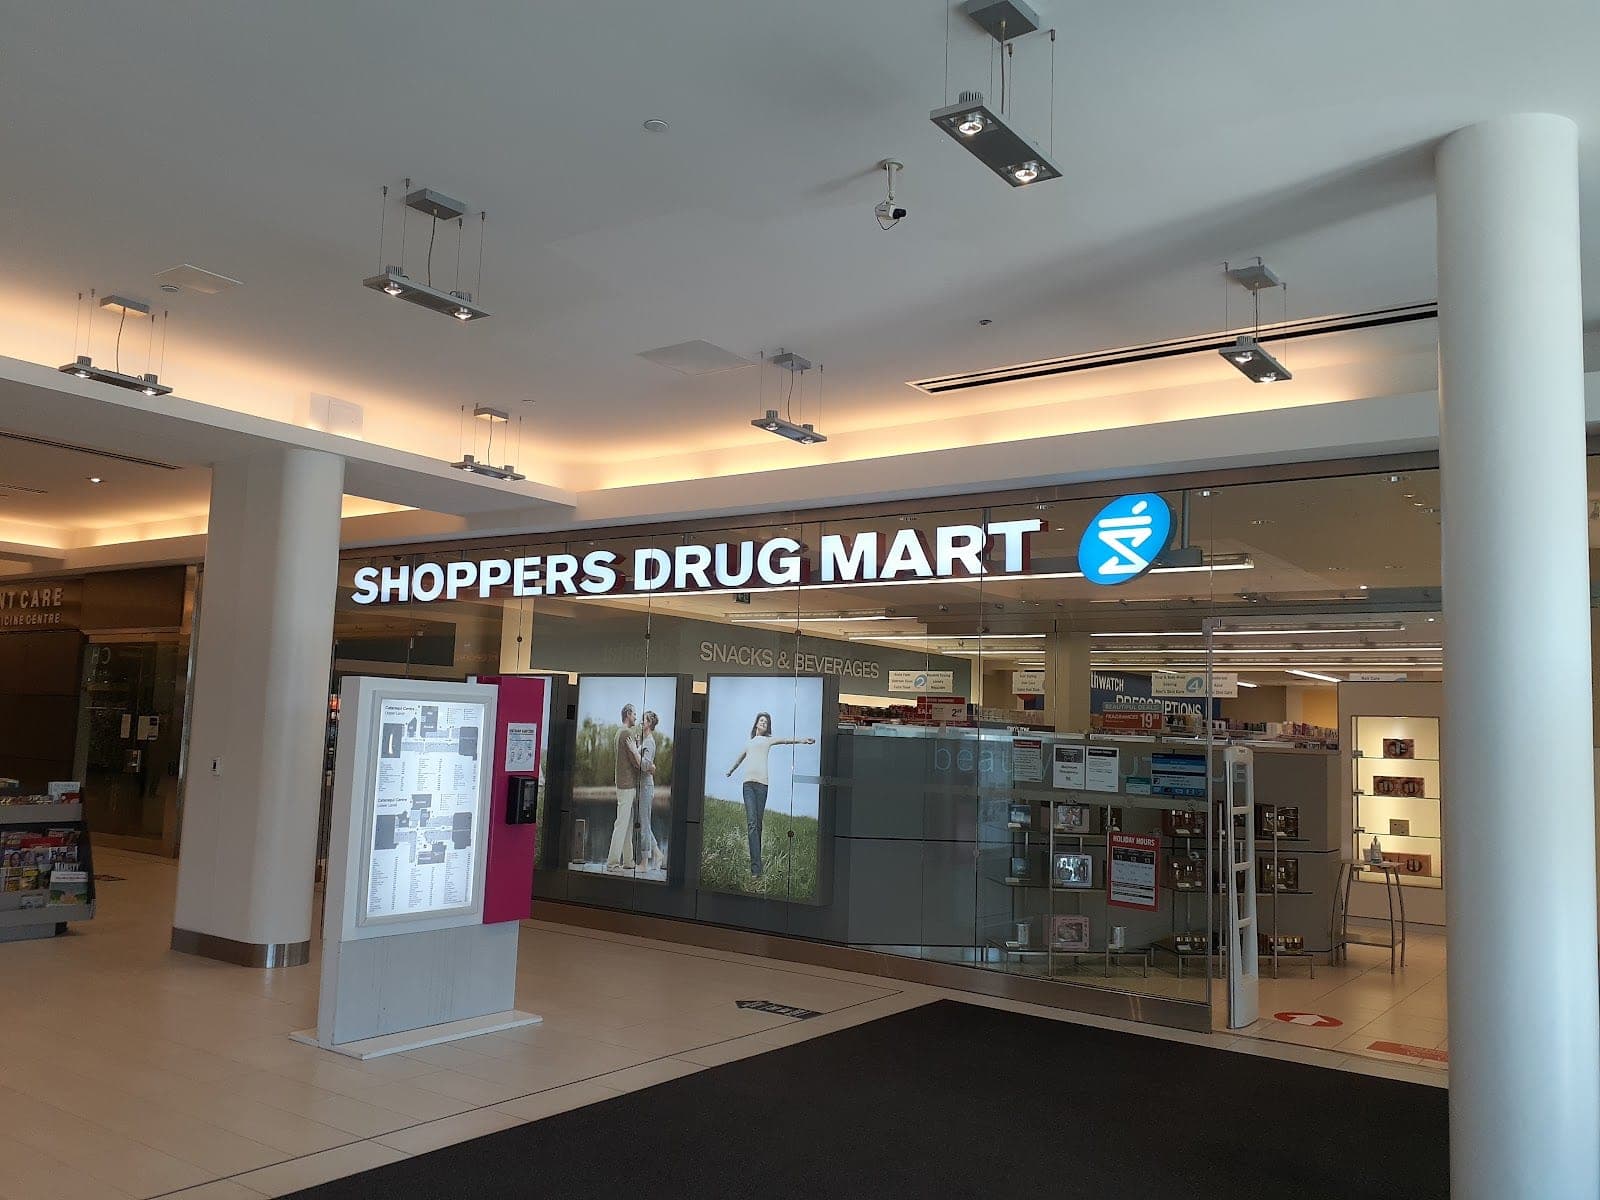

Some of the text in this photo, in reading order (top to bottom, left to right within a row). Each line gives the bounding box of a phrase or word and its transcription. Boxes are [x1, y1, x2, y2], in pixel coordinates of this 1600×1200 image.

[351, 519, 1042, 604] SHOPPERS DRUG MART
[20, 587, 63, 609] CARE
[26, 612, 62, 625] CENTRE
[699, 641, 880, 679] SNACKS & BEVERAGES
[934, 740, 1053, 778] beauy
[1113, 835, 1156, 847] HOLIDAY HOURS
